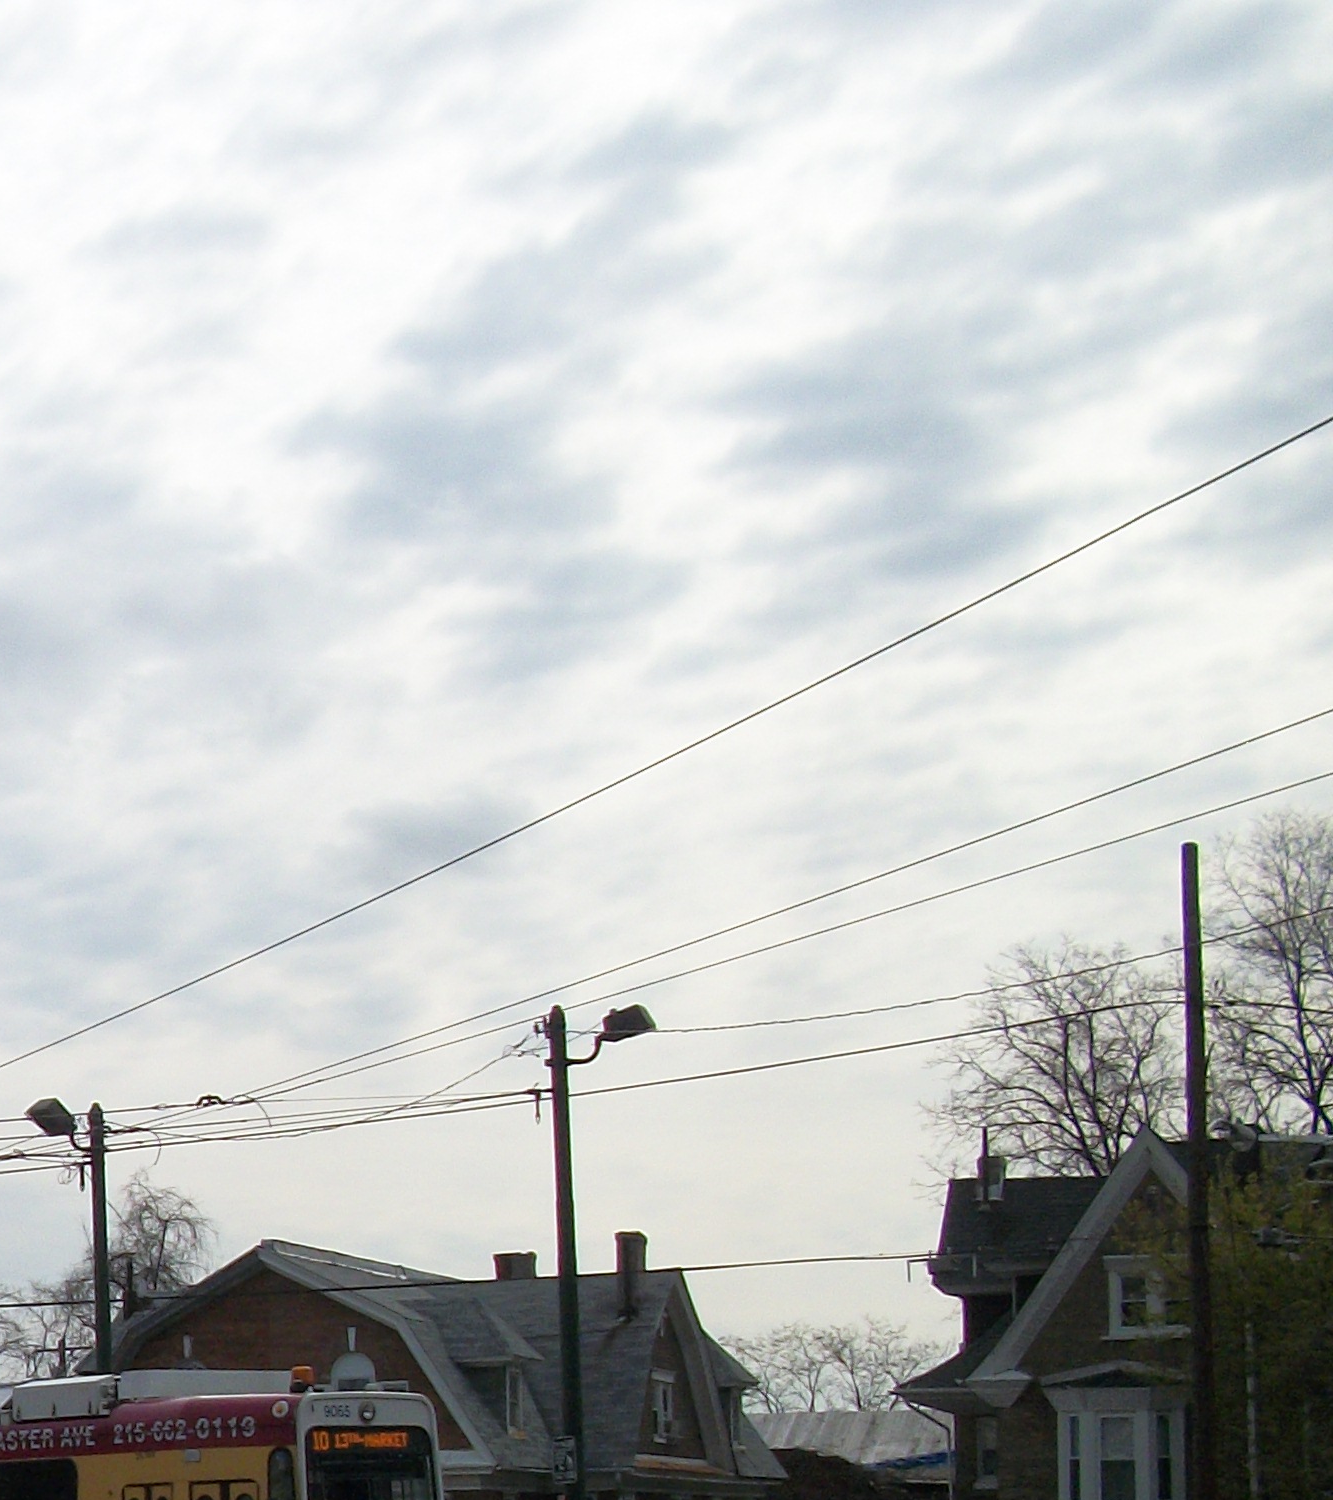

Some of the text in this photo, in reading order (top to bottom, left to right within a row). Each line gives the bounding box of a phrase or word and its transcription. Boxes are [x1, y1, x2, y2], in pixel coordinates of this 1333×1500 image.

[325, 1404, 350, 1418] 9065
[59, 1425, 96, 1448] AVE
[312, 1431, 329, 1451] 10
